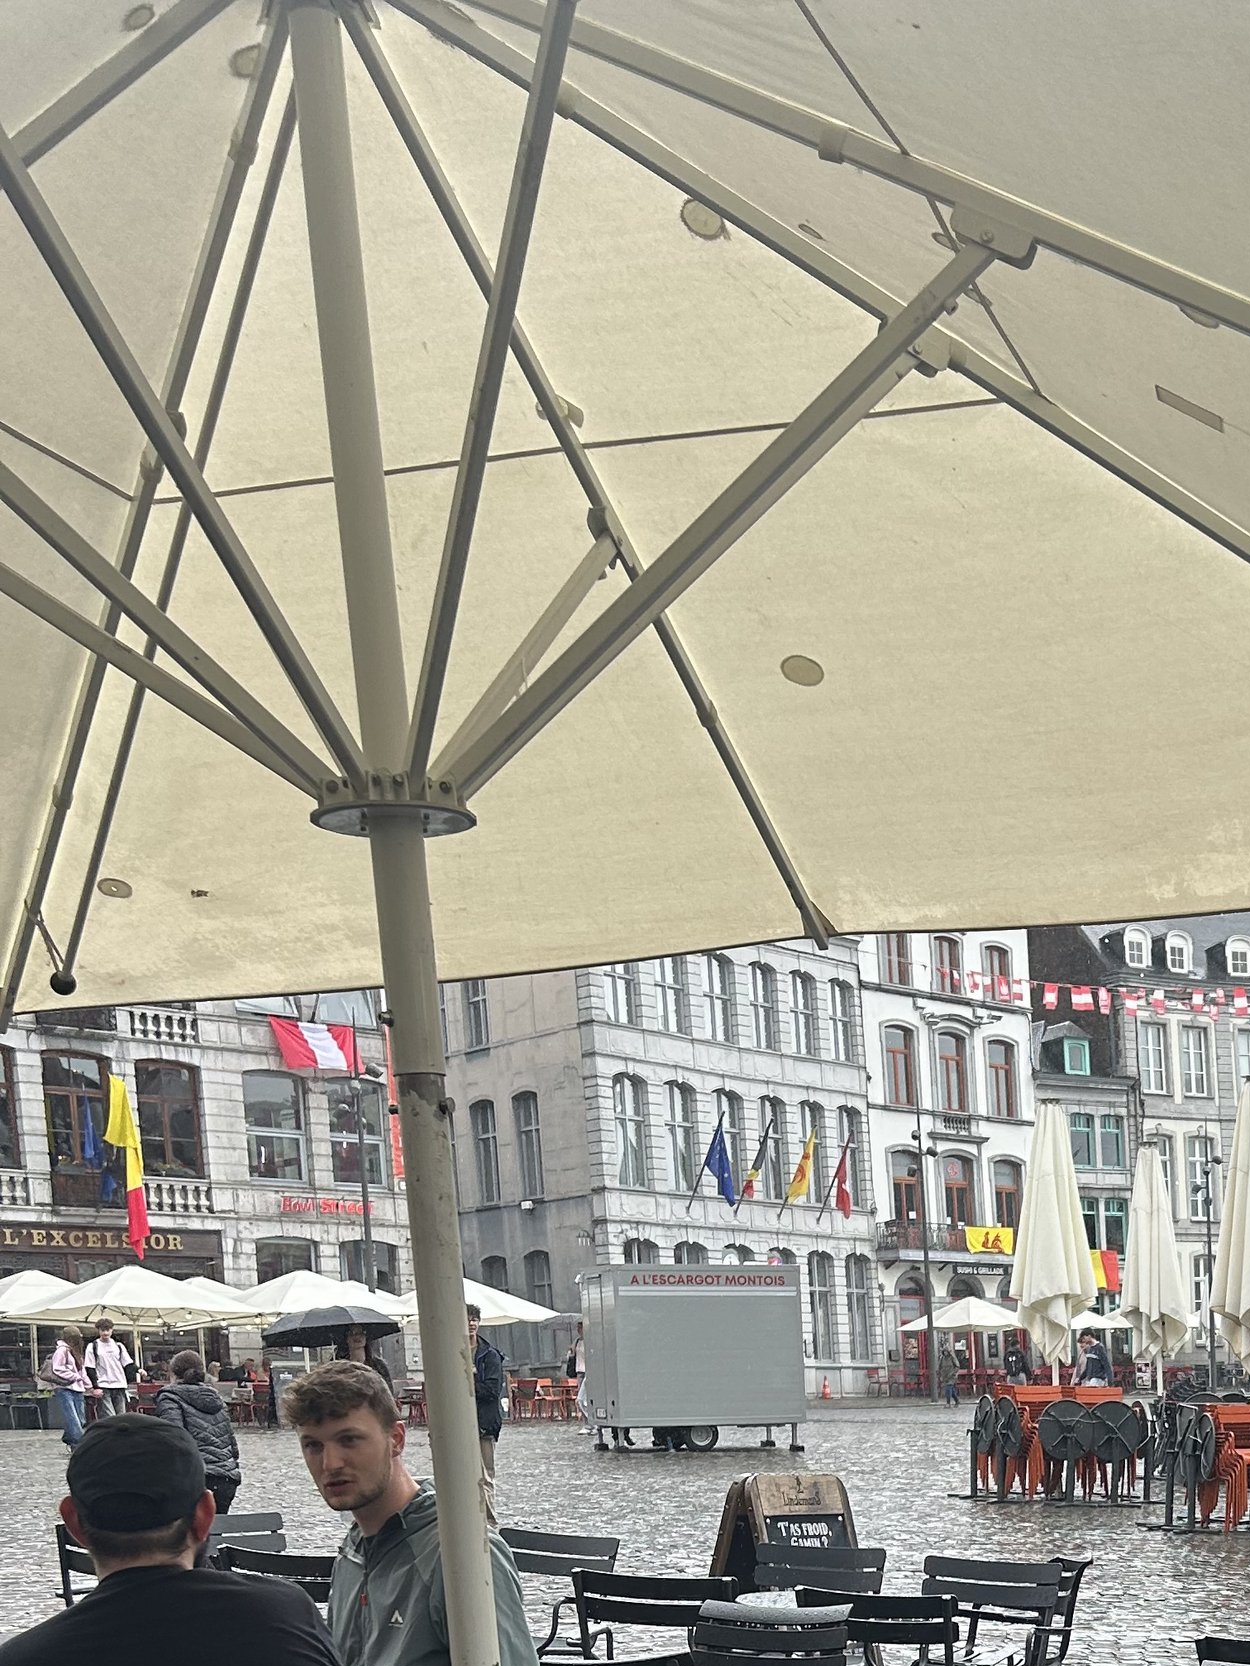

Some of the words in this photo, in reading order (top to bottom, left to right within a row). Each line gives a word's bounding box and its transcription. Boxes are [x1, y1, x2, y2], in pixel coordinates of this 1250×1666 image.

[630, 1275, 639, 1285] A
[643, 1274, 721, 1286] L'ESCARGOT
[724, 1275, 785, 1286] MONTOIS
[801, 1522, 832, 1537] FROID,
